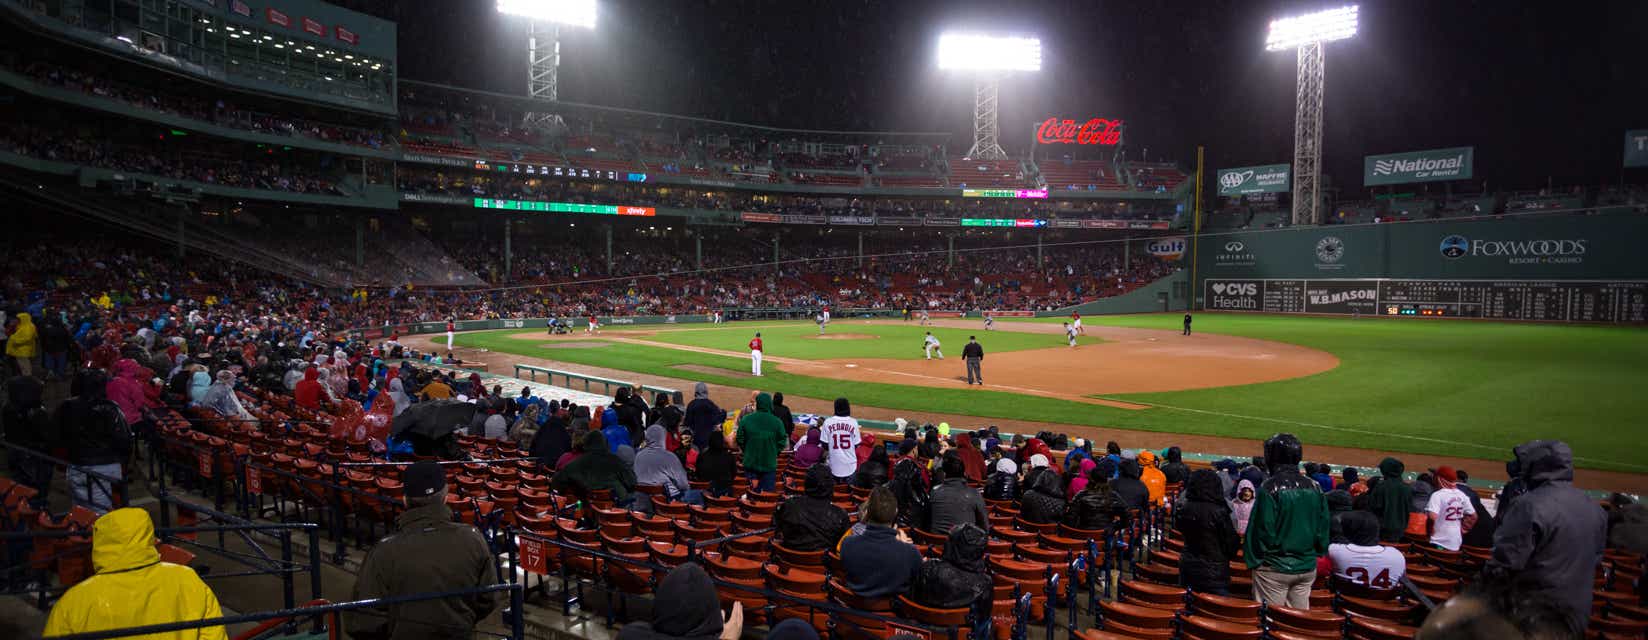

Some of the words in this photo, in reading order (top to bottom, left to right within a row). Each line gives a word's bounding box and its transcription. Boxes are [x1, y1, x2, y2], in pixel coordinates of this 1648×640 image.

[1392, 155, 1464, 173] National
[1432, 169, 1460, 177] Rental
[1146, 241, 1185, 254] Gulf
[1471, 240, 1586, 256] FOXWOODS
[1509, 256, 1541, 264] RESORT
[1226, 283, 1257, 296] CVS
[1214, 296, 1257, 309] Health
[828, 423, 856, 434] PEDROIA
[832, 434, 852, 450] 15
[1446, 506, 1464, 521] 25
[528, 554, 541, 567] 17
